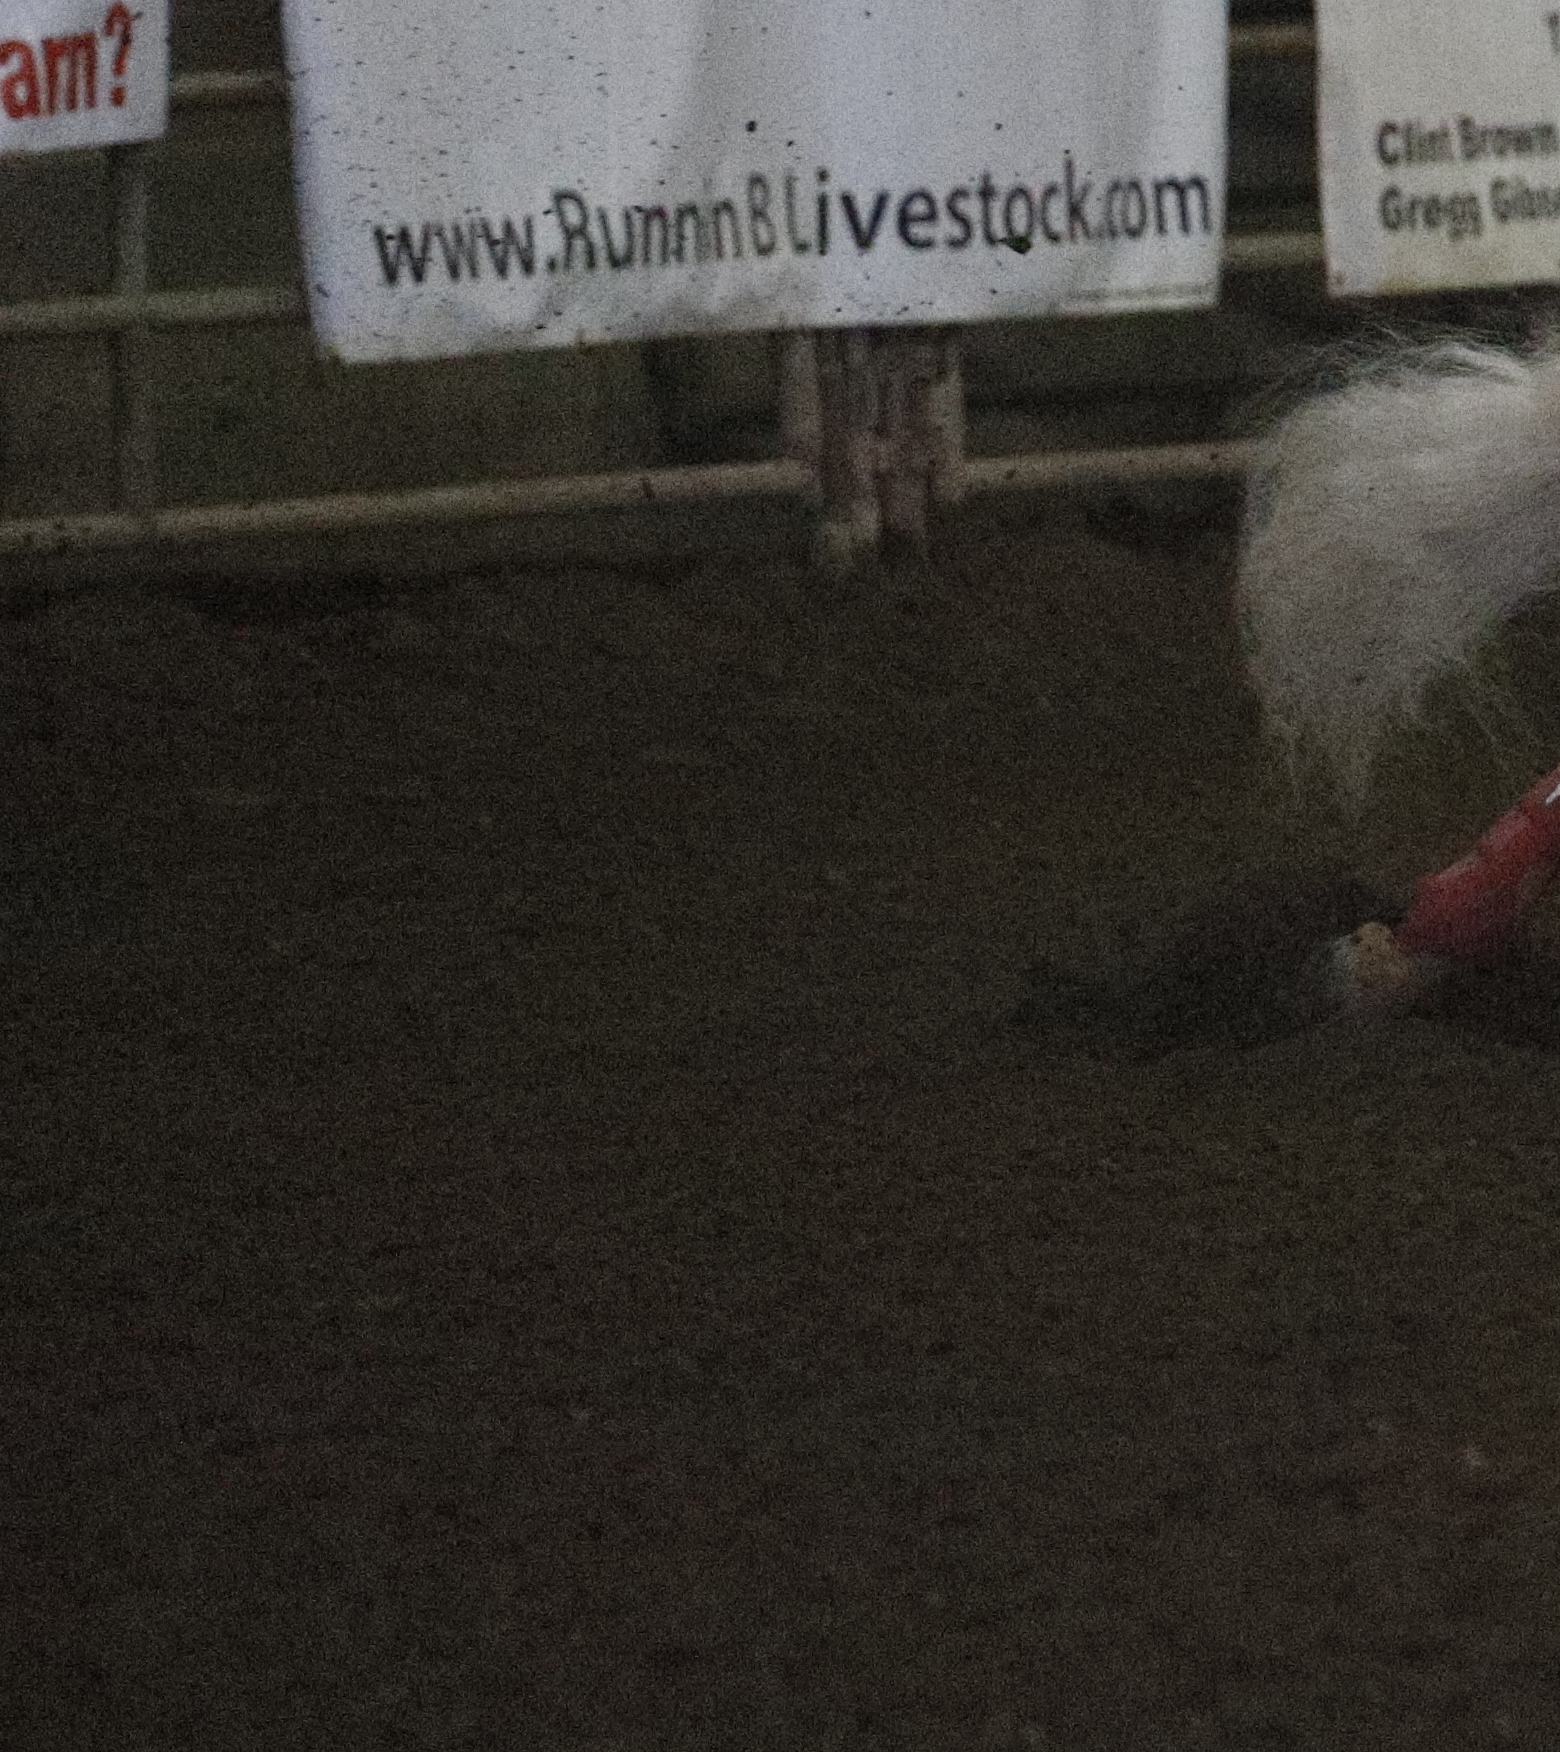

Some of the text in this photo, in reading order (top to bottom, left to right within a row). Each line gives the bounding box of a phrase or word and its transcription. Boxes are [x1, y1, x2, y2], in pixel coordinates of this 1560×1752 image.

[1377, 117, 1559, 167] Clint Brown
[1380, 187, 1482, 236] Gregg
